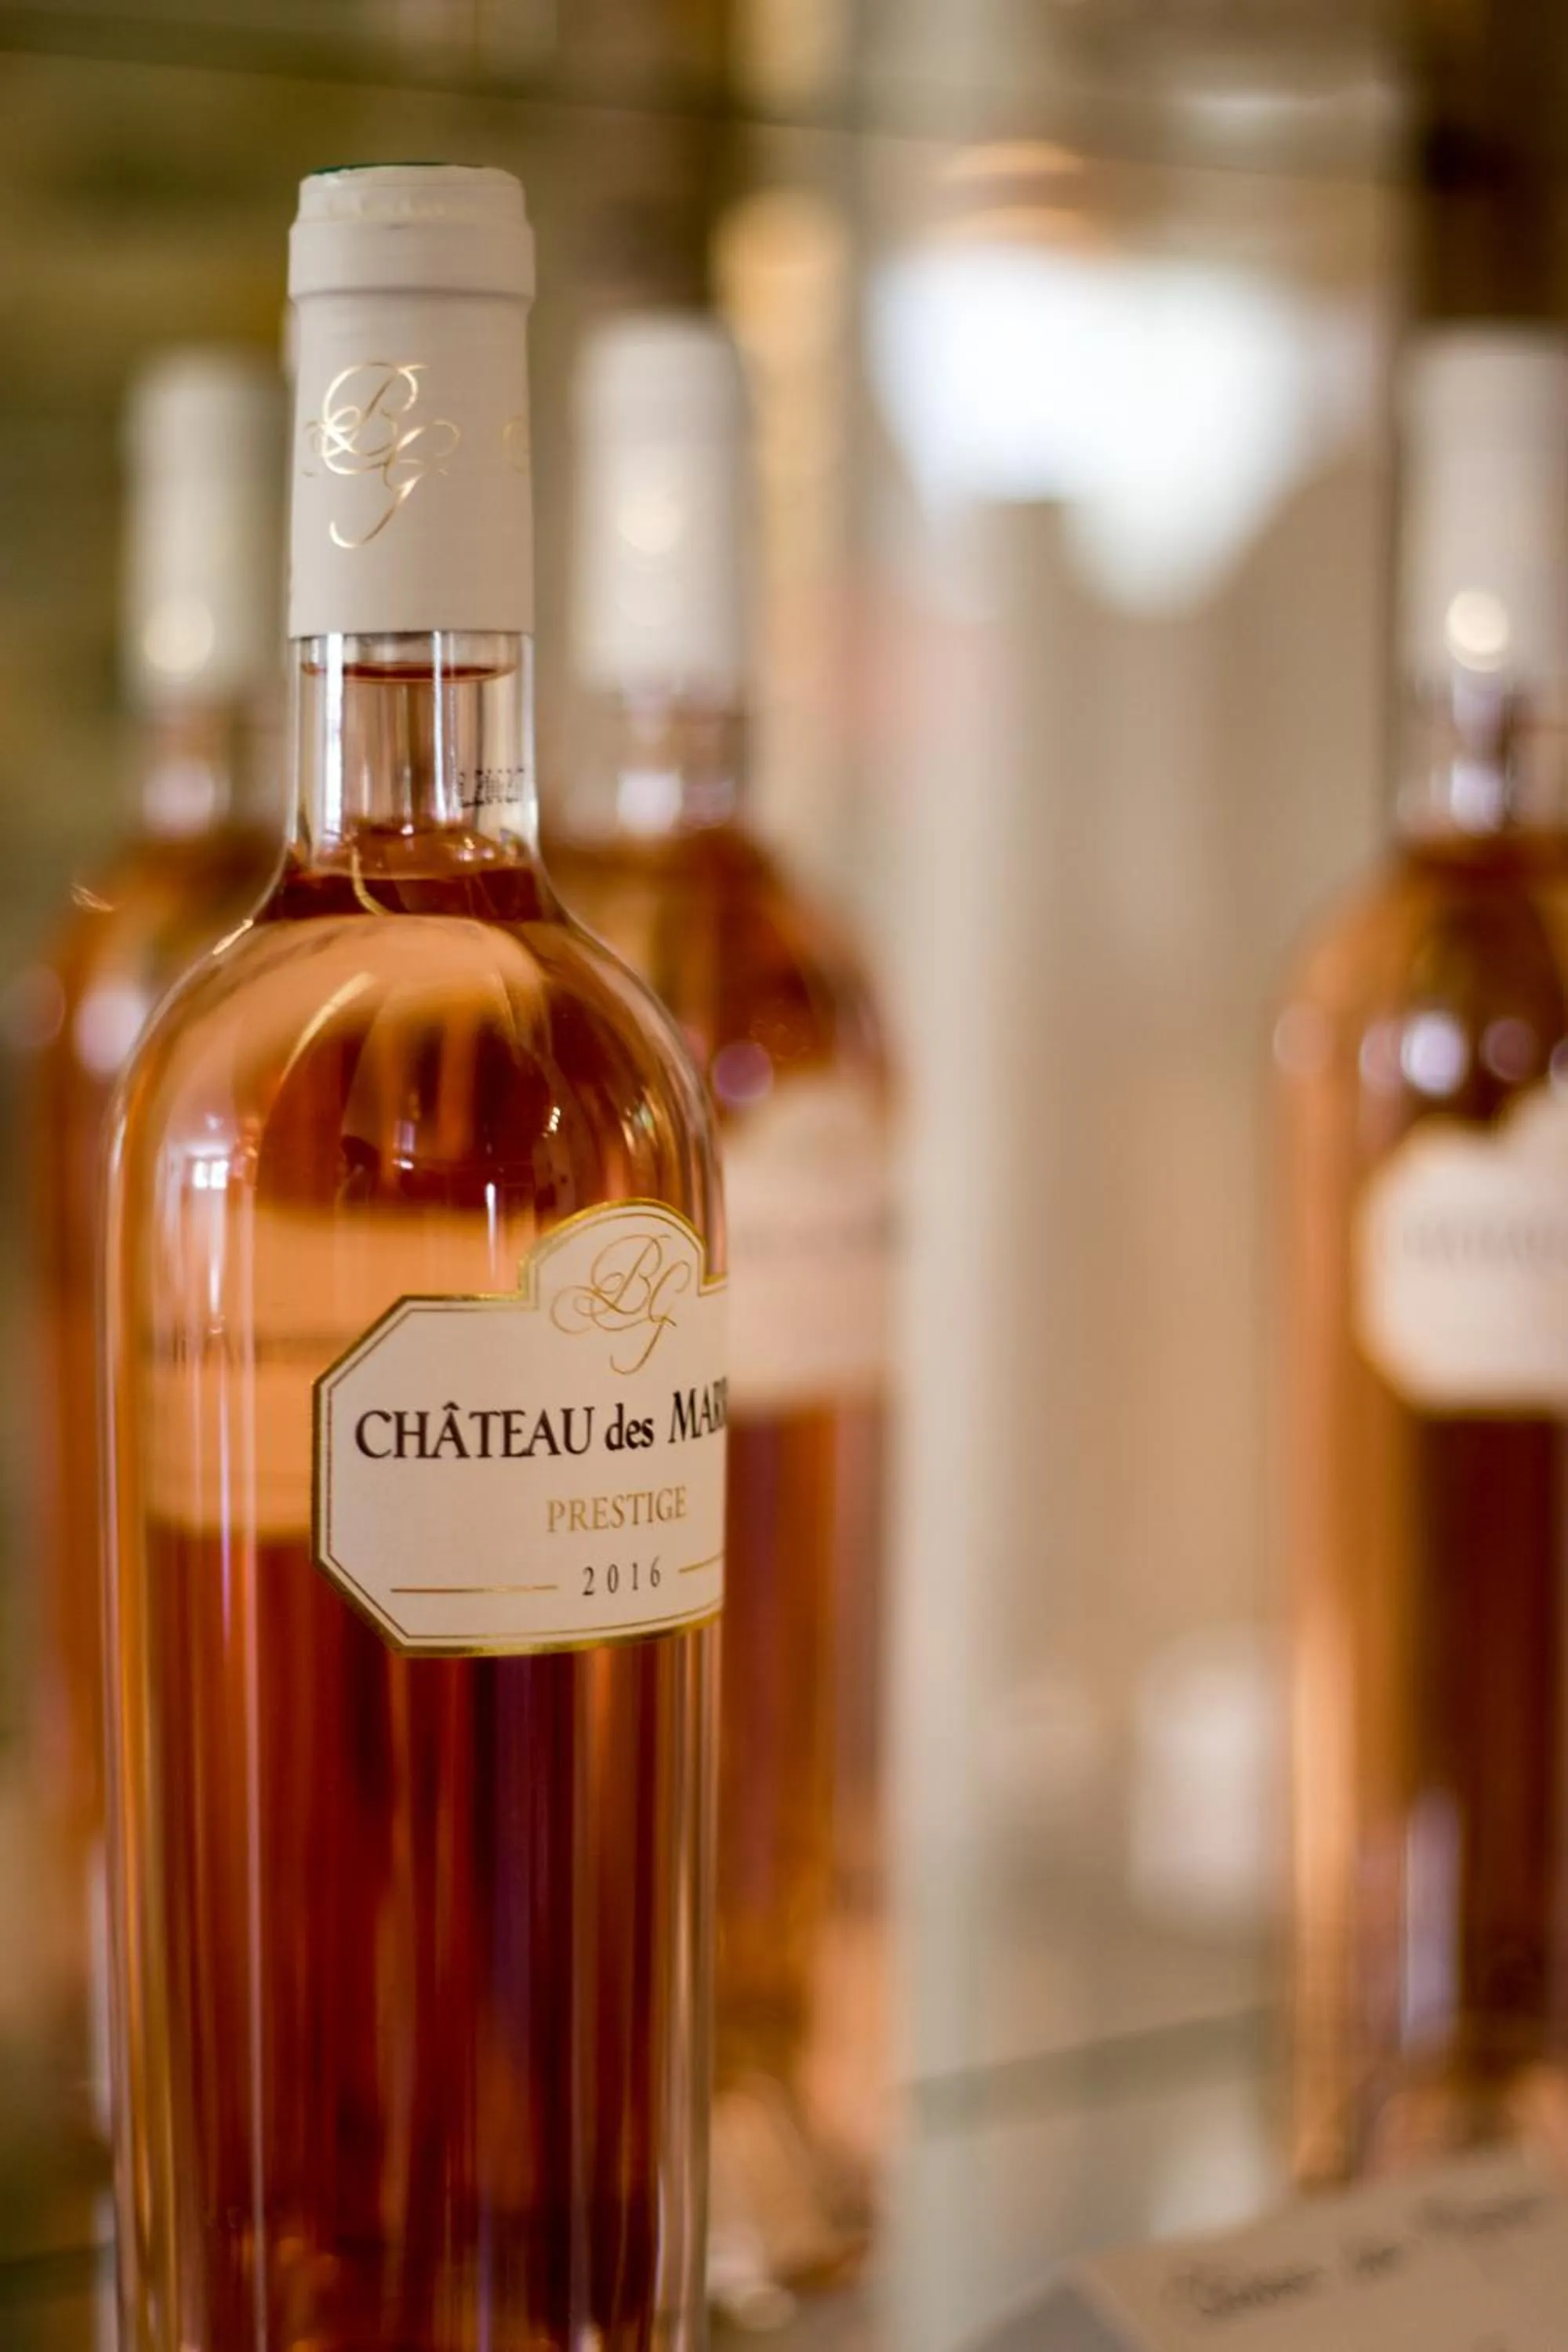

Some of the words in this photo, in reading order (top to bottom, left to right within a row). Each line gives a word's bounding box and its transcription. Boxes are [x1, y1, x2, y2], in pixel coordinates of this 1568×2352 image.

[354, 1399, 595, 1459] CHÂTEAU
[604, 1402, 654, 1451] des
[546, 1485, 687, 1533] PRESTIGE
[582, 1555, 662, 1596] 2016
